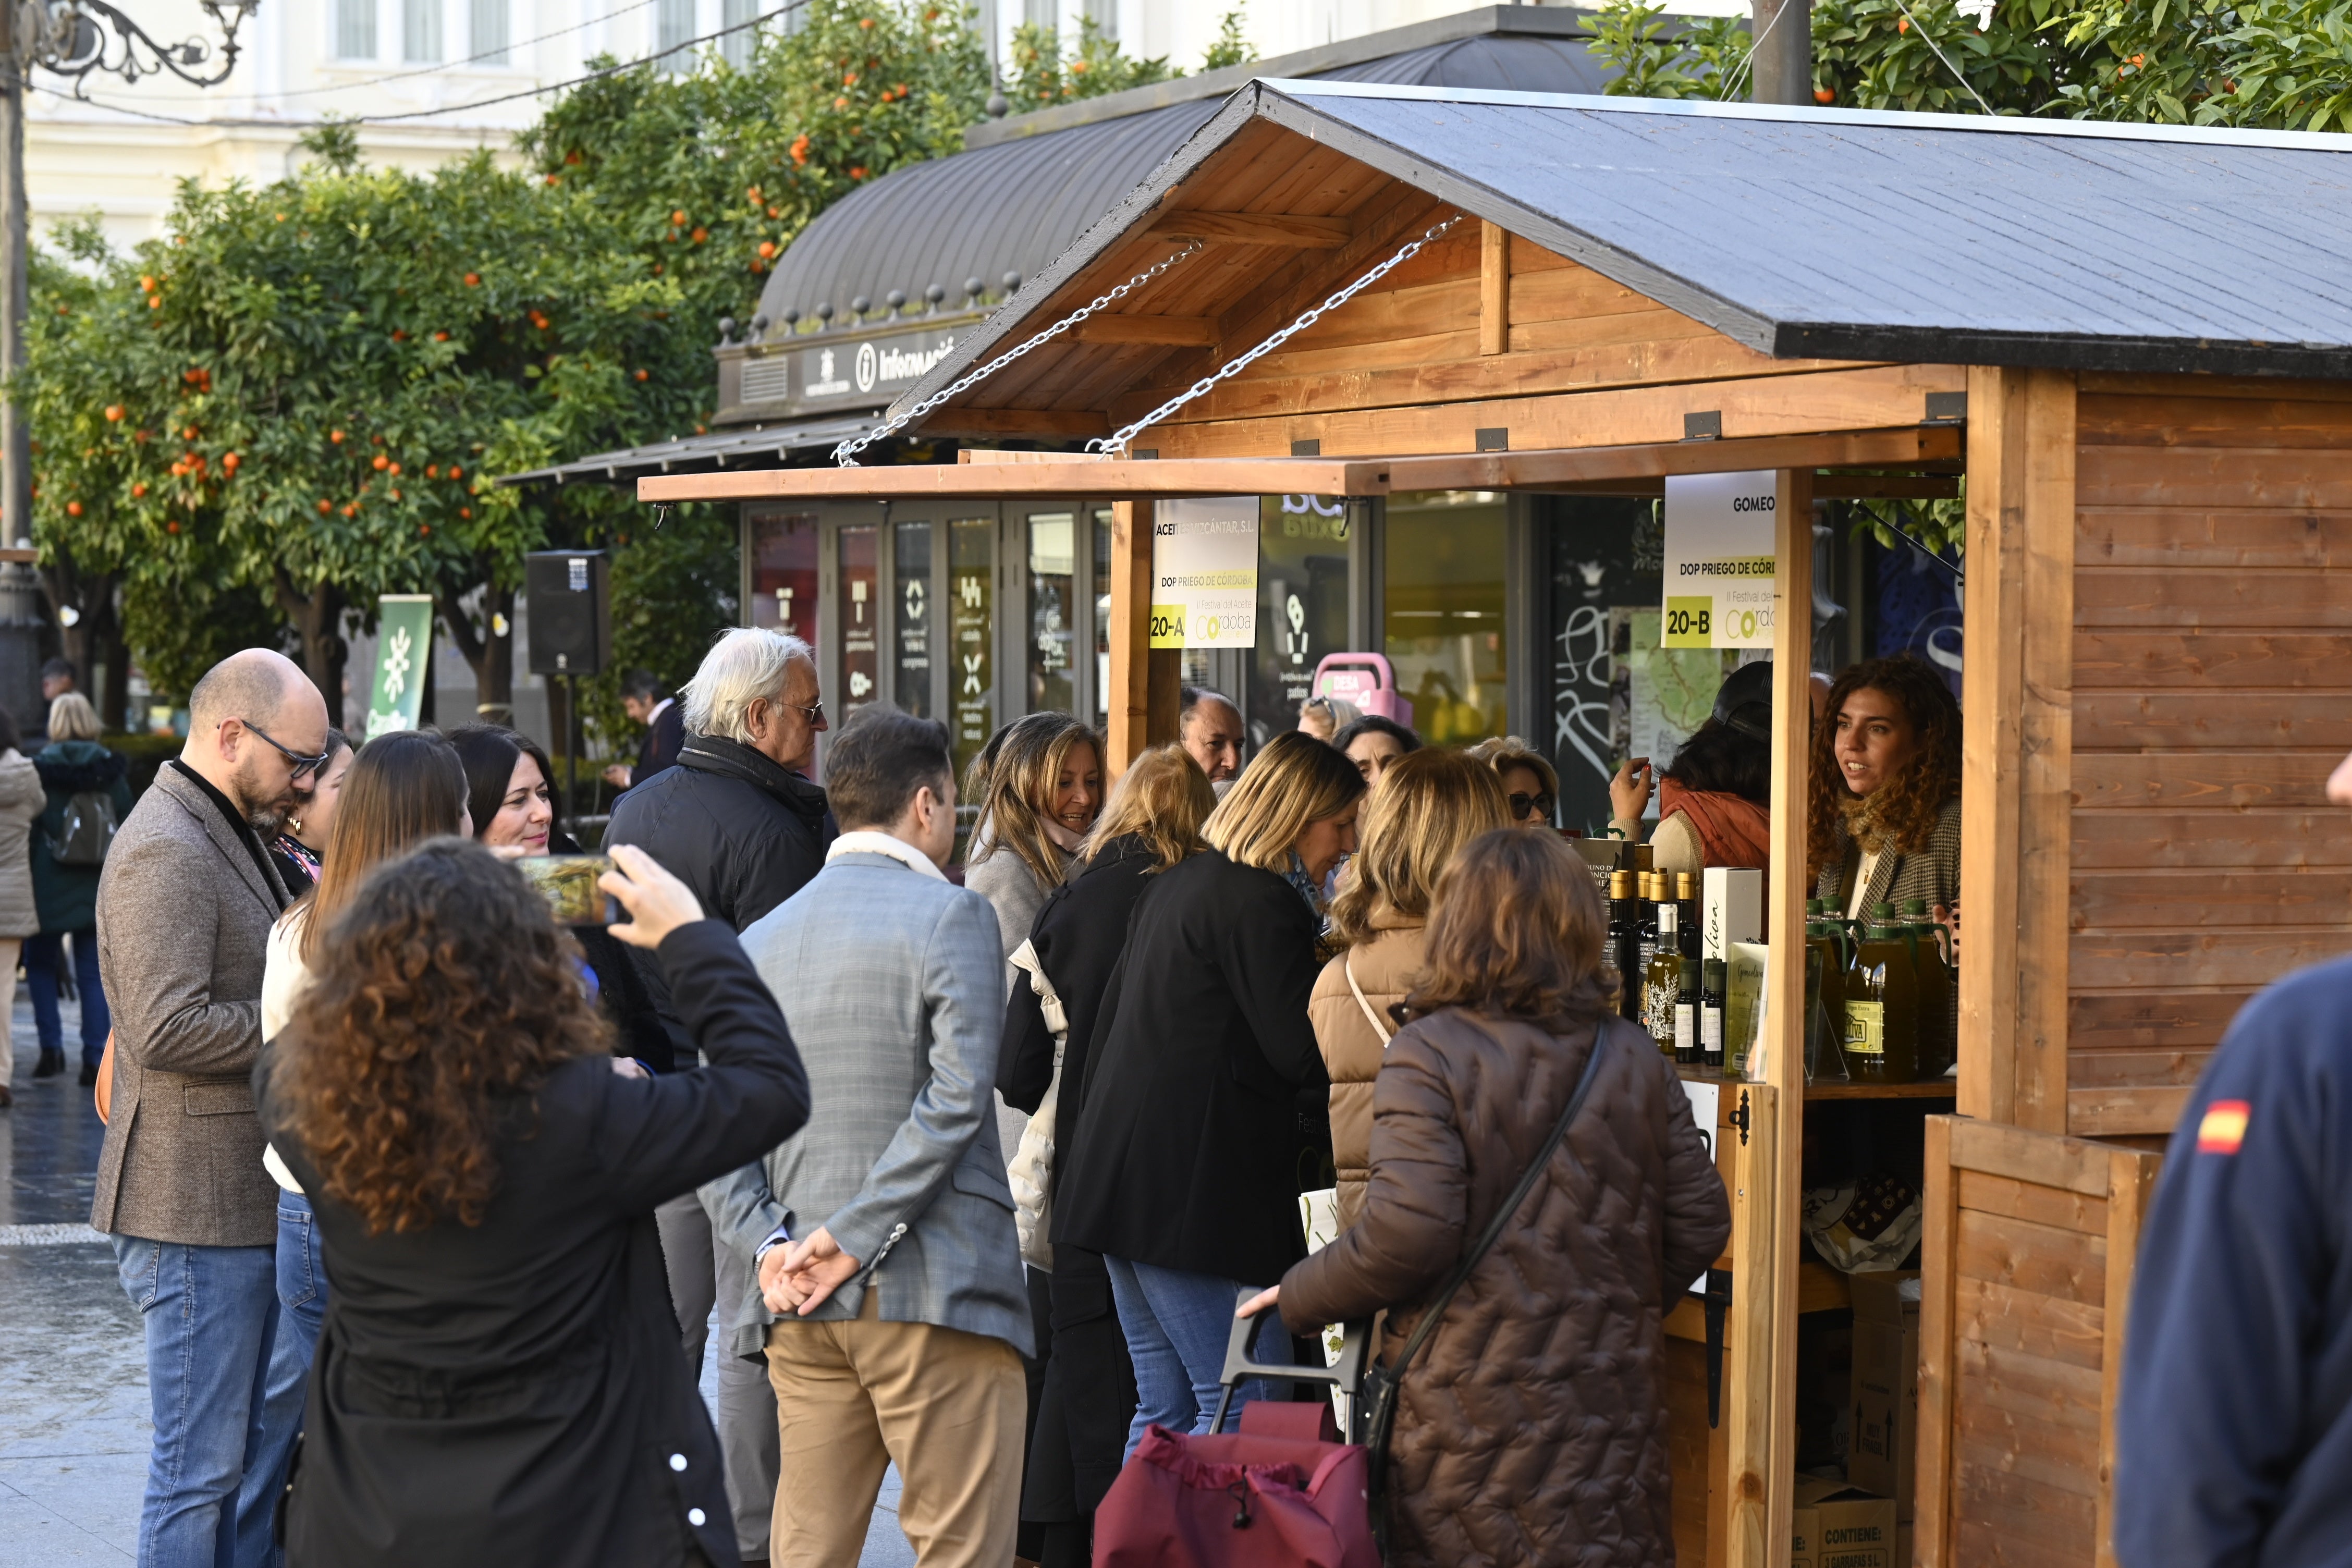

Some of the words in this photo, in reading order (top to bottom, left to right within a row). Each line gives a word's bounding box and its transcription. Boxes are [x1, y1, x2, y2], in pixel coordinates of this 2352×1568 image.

[1156, 522, 1190, 536] ACEITES
[1191, 518, 1240, 536] VIZCÁNTAR,
[1241, 520, 1254, 532] S.L.
[1680, 564, 1700, 575] DOP
[1701, 562, 1736, 575] PRIEGO
[1738, 562, 1750, 574] DE
[1162, 577, 1177, 587] DOP
[1178, 575, 1204, 586] PRIEGO
[1206, 575, 1215, 586] DE
[1217, 572, 1253, 585] CÓRDOBA
[1201, 600, 1222, 609] Festival
[1223, 599, 1232, 609] del
[1234, 599, 1252, 609] Aceite
[1732, 591, 1759, 602] Festival
[1760, 591, 1772, 602] del
[1151, 616, 1184, 636] 20-A
[1196, 611, 1251, 640] Córdoba
[1668, 610, 1710, 634] 20-B
[1333, 675, 1359, 691] DESA
[1866, 1422, 1880, 1439] MUY
[1862, 1437, 1883, 1457] FRAGIL
[1825, 1526, 1881, 1545] CONTIENE:
[1826, 1558, 1830, 1568] 3
[1831, 1554, 1866, 1568] GARRAFAS
[1867, 1553, 1872, 1566] 5
